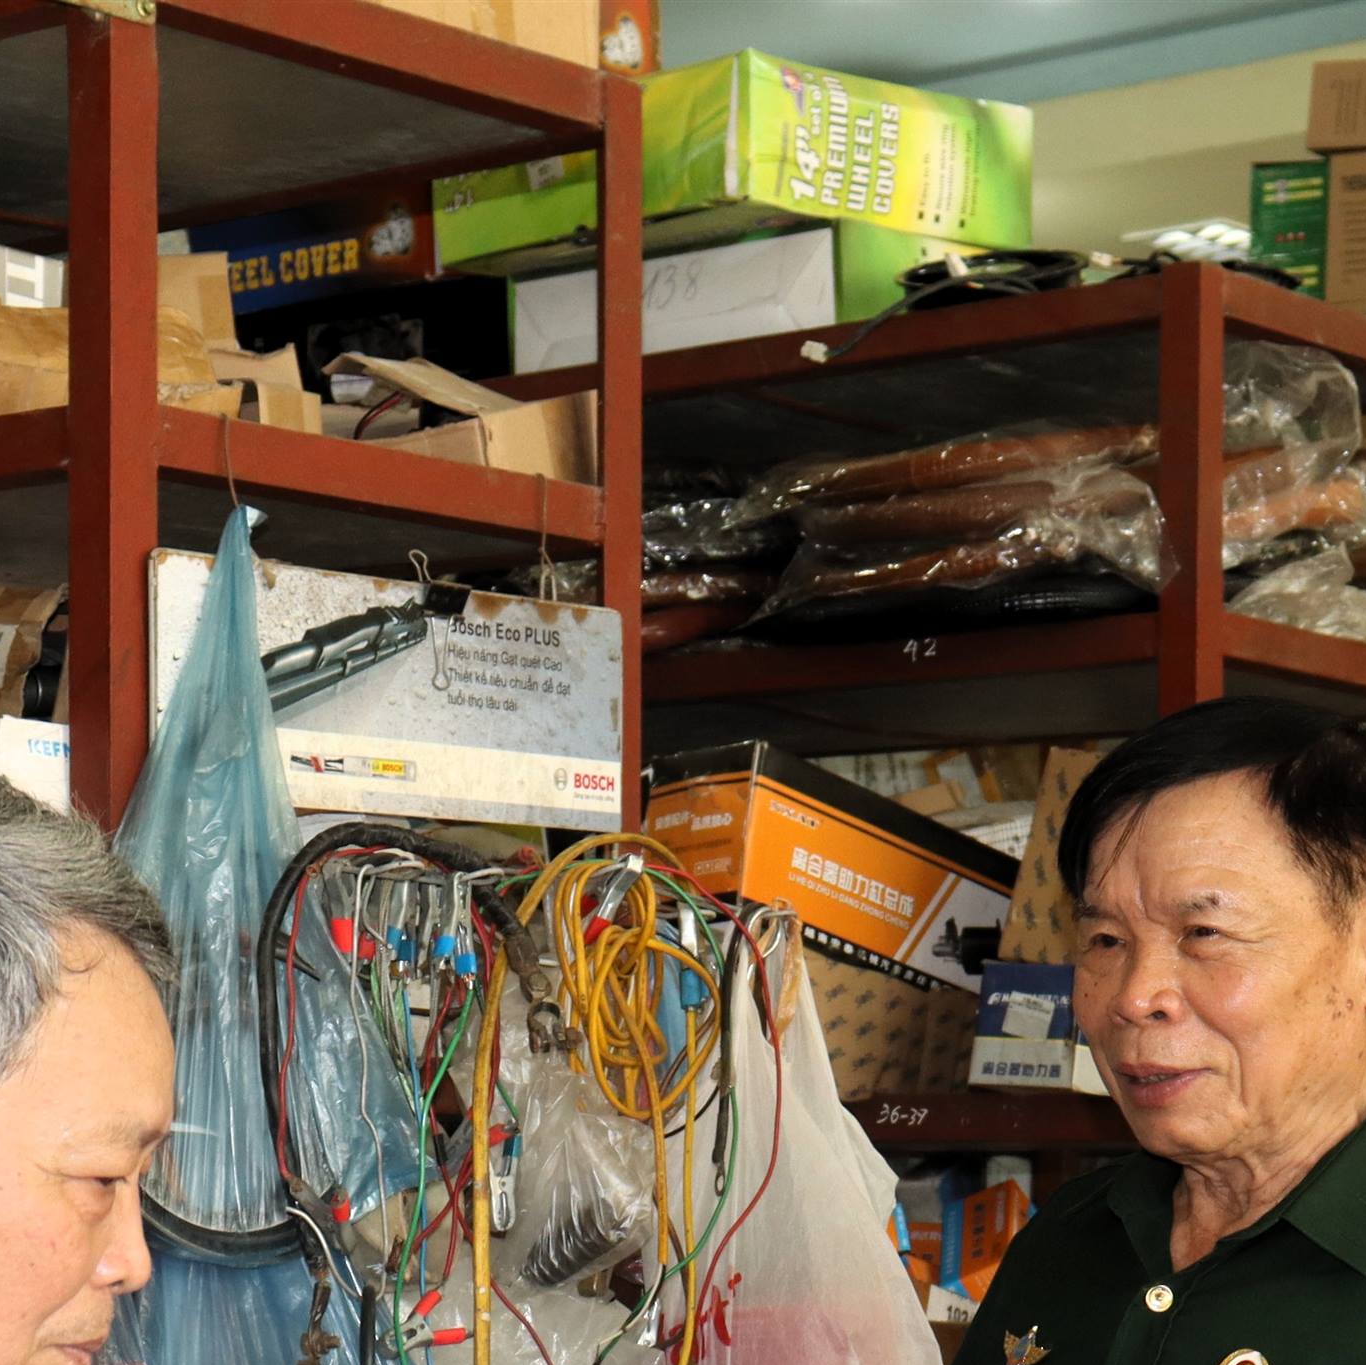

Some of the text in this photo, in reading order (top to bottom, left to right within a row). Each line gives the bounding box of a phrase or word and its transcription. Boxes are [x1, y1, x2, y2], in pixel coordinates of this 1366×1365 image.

[845, 111, 875, 211] WHEEL
[872, 103, 900, 214] COVERS
[278, 238, 361, 283] COVER
[495, 622, 521, 642] Eco
[524, 626, 561, 648] PLUS
[903, 637, 937, 663] 42
[543, 656, 563, 672] Cao
[573, 772, 615, 792] BOSCH
